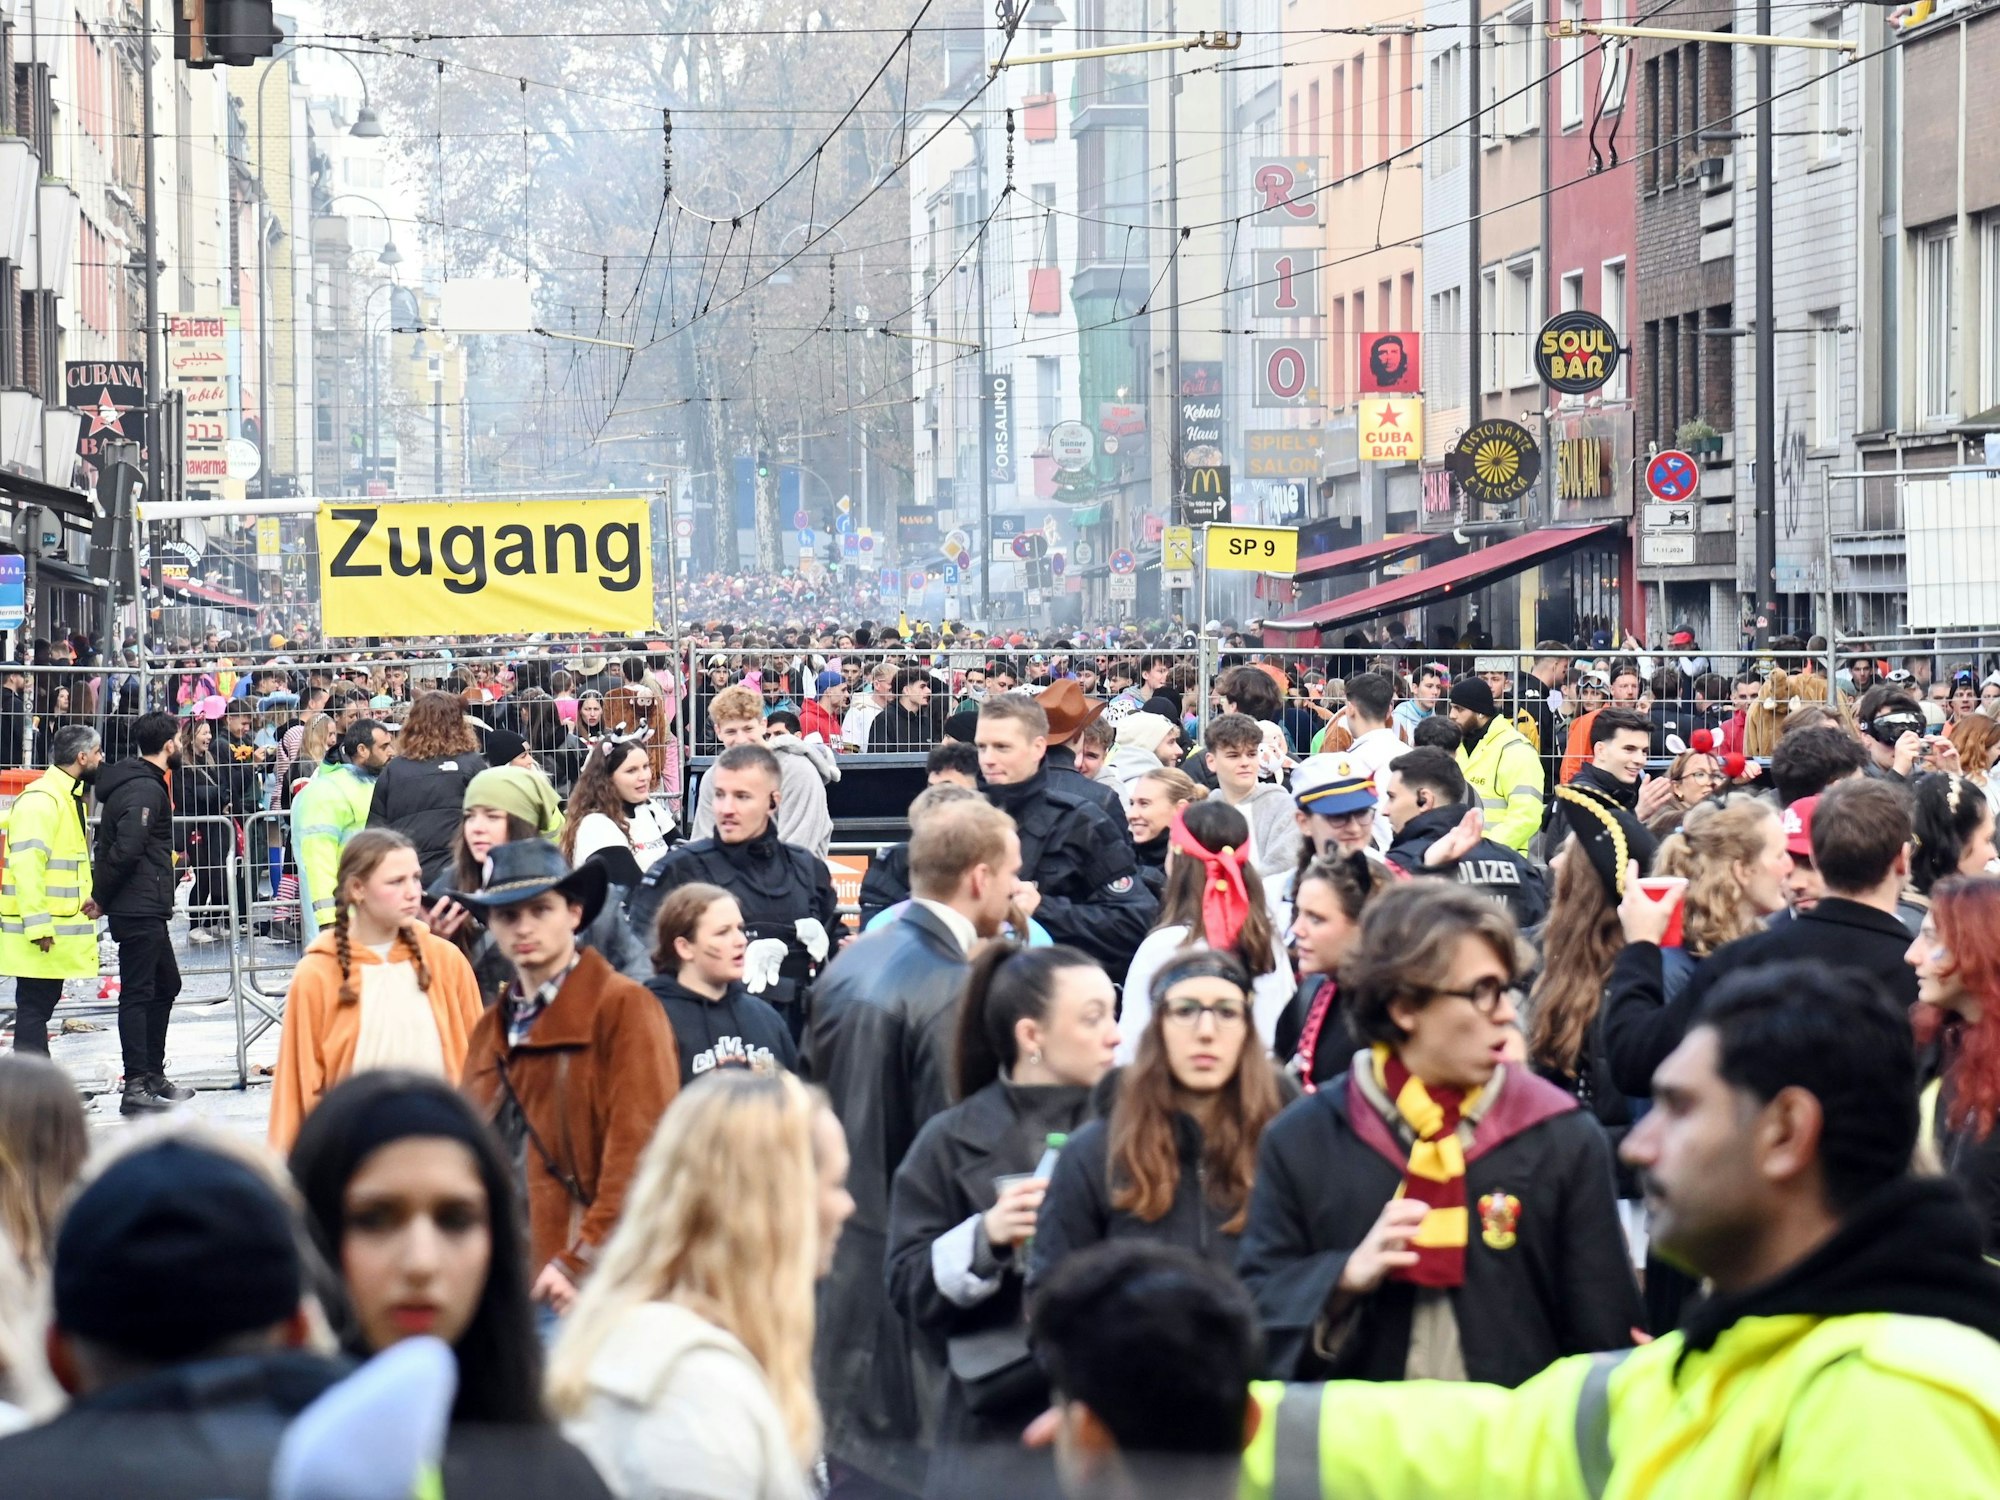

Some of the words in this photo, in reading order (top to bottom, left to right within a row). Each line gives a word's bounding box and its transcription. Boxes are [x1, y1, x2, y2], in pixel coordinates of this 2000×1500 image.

[1542, 330, 1612, 354] SOUL
[67, 363, 142, 388] CUBANA
[1551, 355, 1604, 379] BAR
[186, 386, 224, 402] abibi
[1183, 403, 1221, 422] Kebab
[1187, 426, 1218, 441] Haus
[1251, 435, 1302, 450] SPIEL
[1365, 431, 1413, 443] CUBA
[1461, 423, 1532, 454] RISTORANTE
[1372, 445, 1407, 457] BAR
[1251, 457, 1318, 474] SALON
[1465, 476, 1528, 499] ETRUSCA
[899, 516, 933, 525] MANGO
[330, 508, 641, 594] Zugang
[1229, 538, 1257, 555] SP
[1264, 540, 1275, 556] 9
[1459, 860, 1520, 884] OLIZEI
